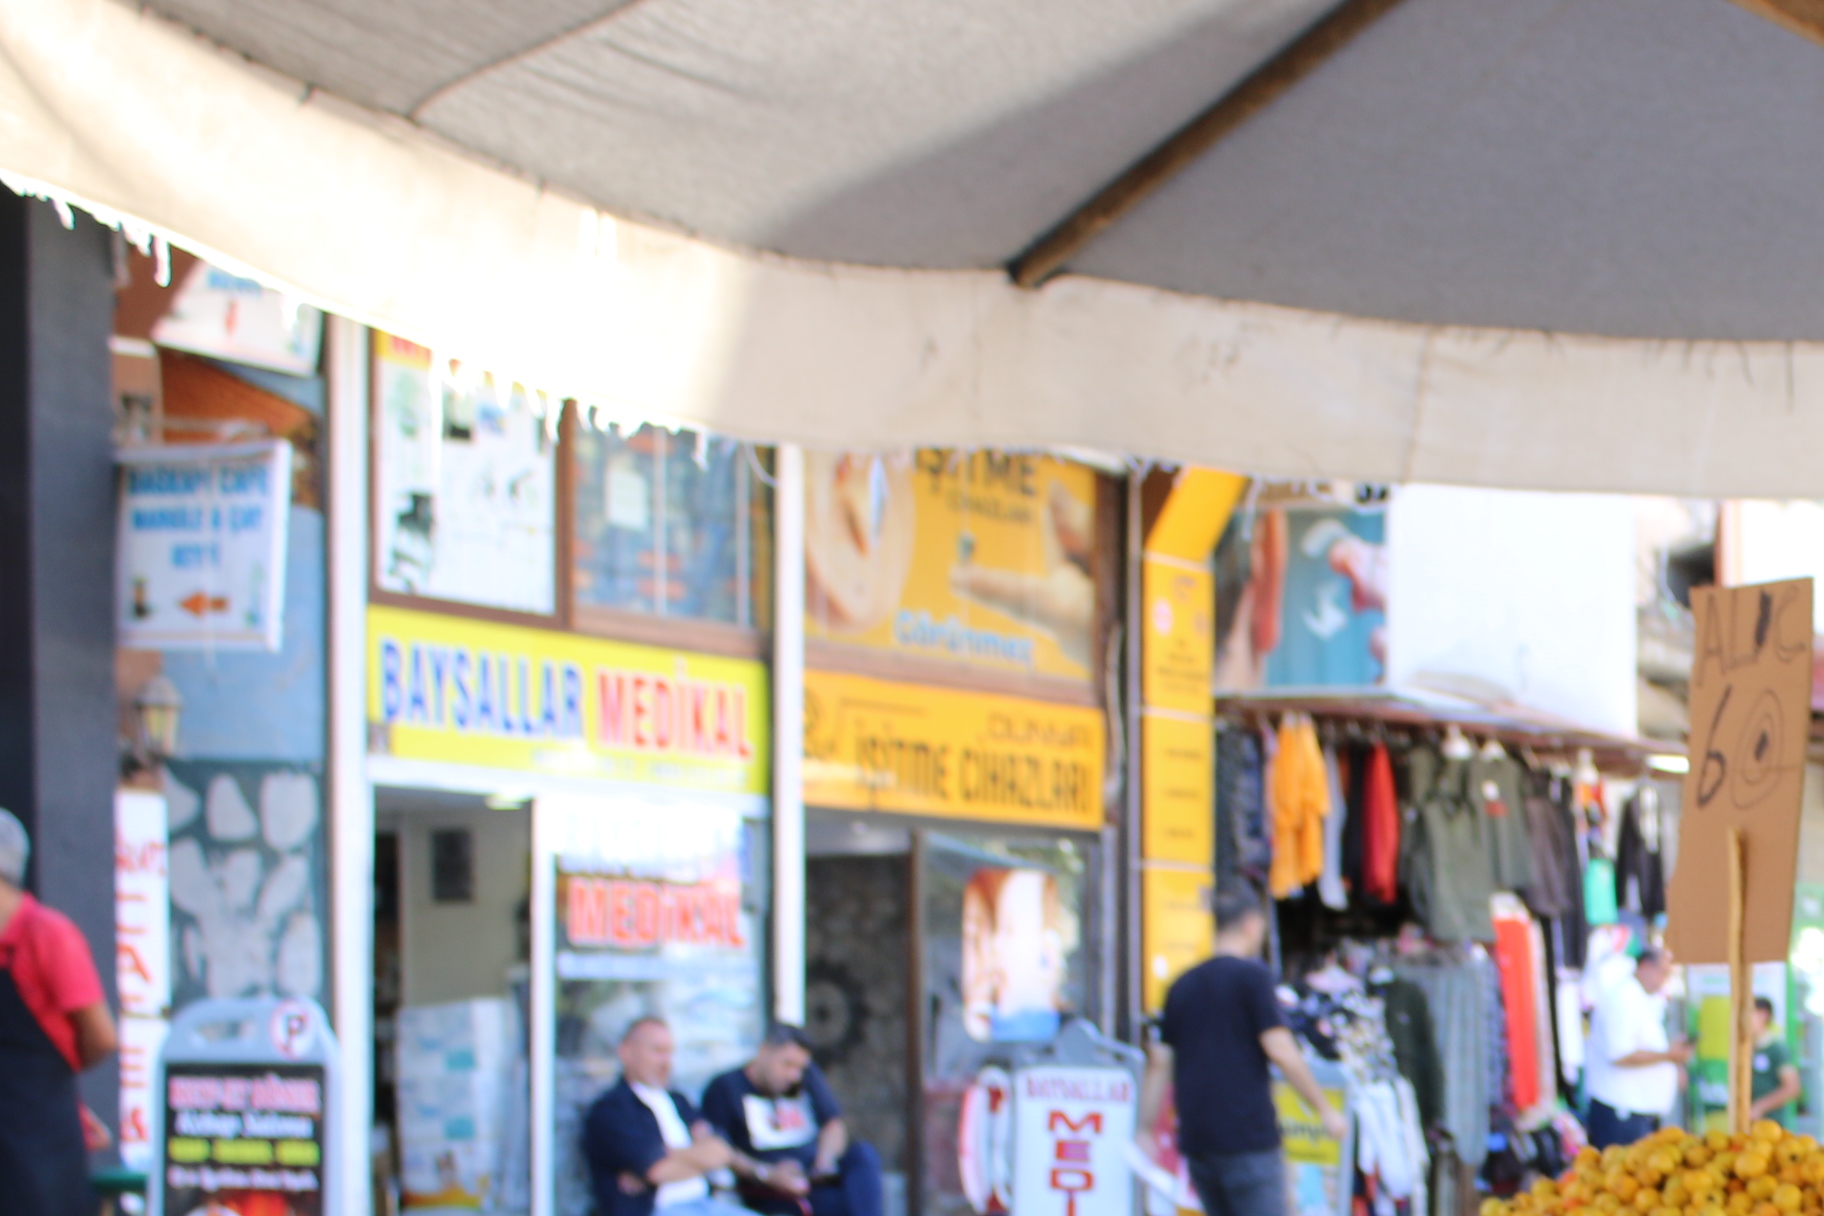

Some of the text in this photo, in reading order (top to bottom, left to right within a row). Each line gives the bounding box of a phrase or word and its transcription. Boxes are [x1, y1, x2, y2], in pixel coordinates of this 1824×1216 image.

[380, 637, 753, 762] BAYSALLAR MEDİKAL
[567, 877, 746, 948] MEDİKAL
